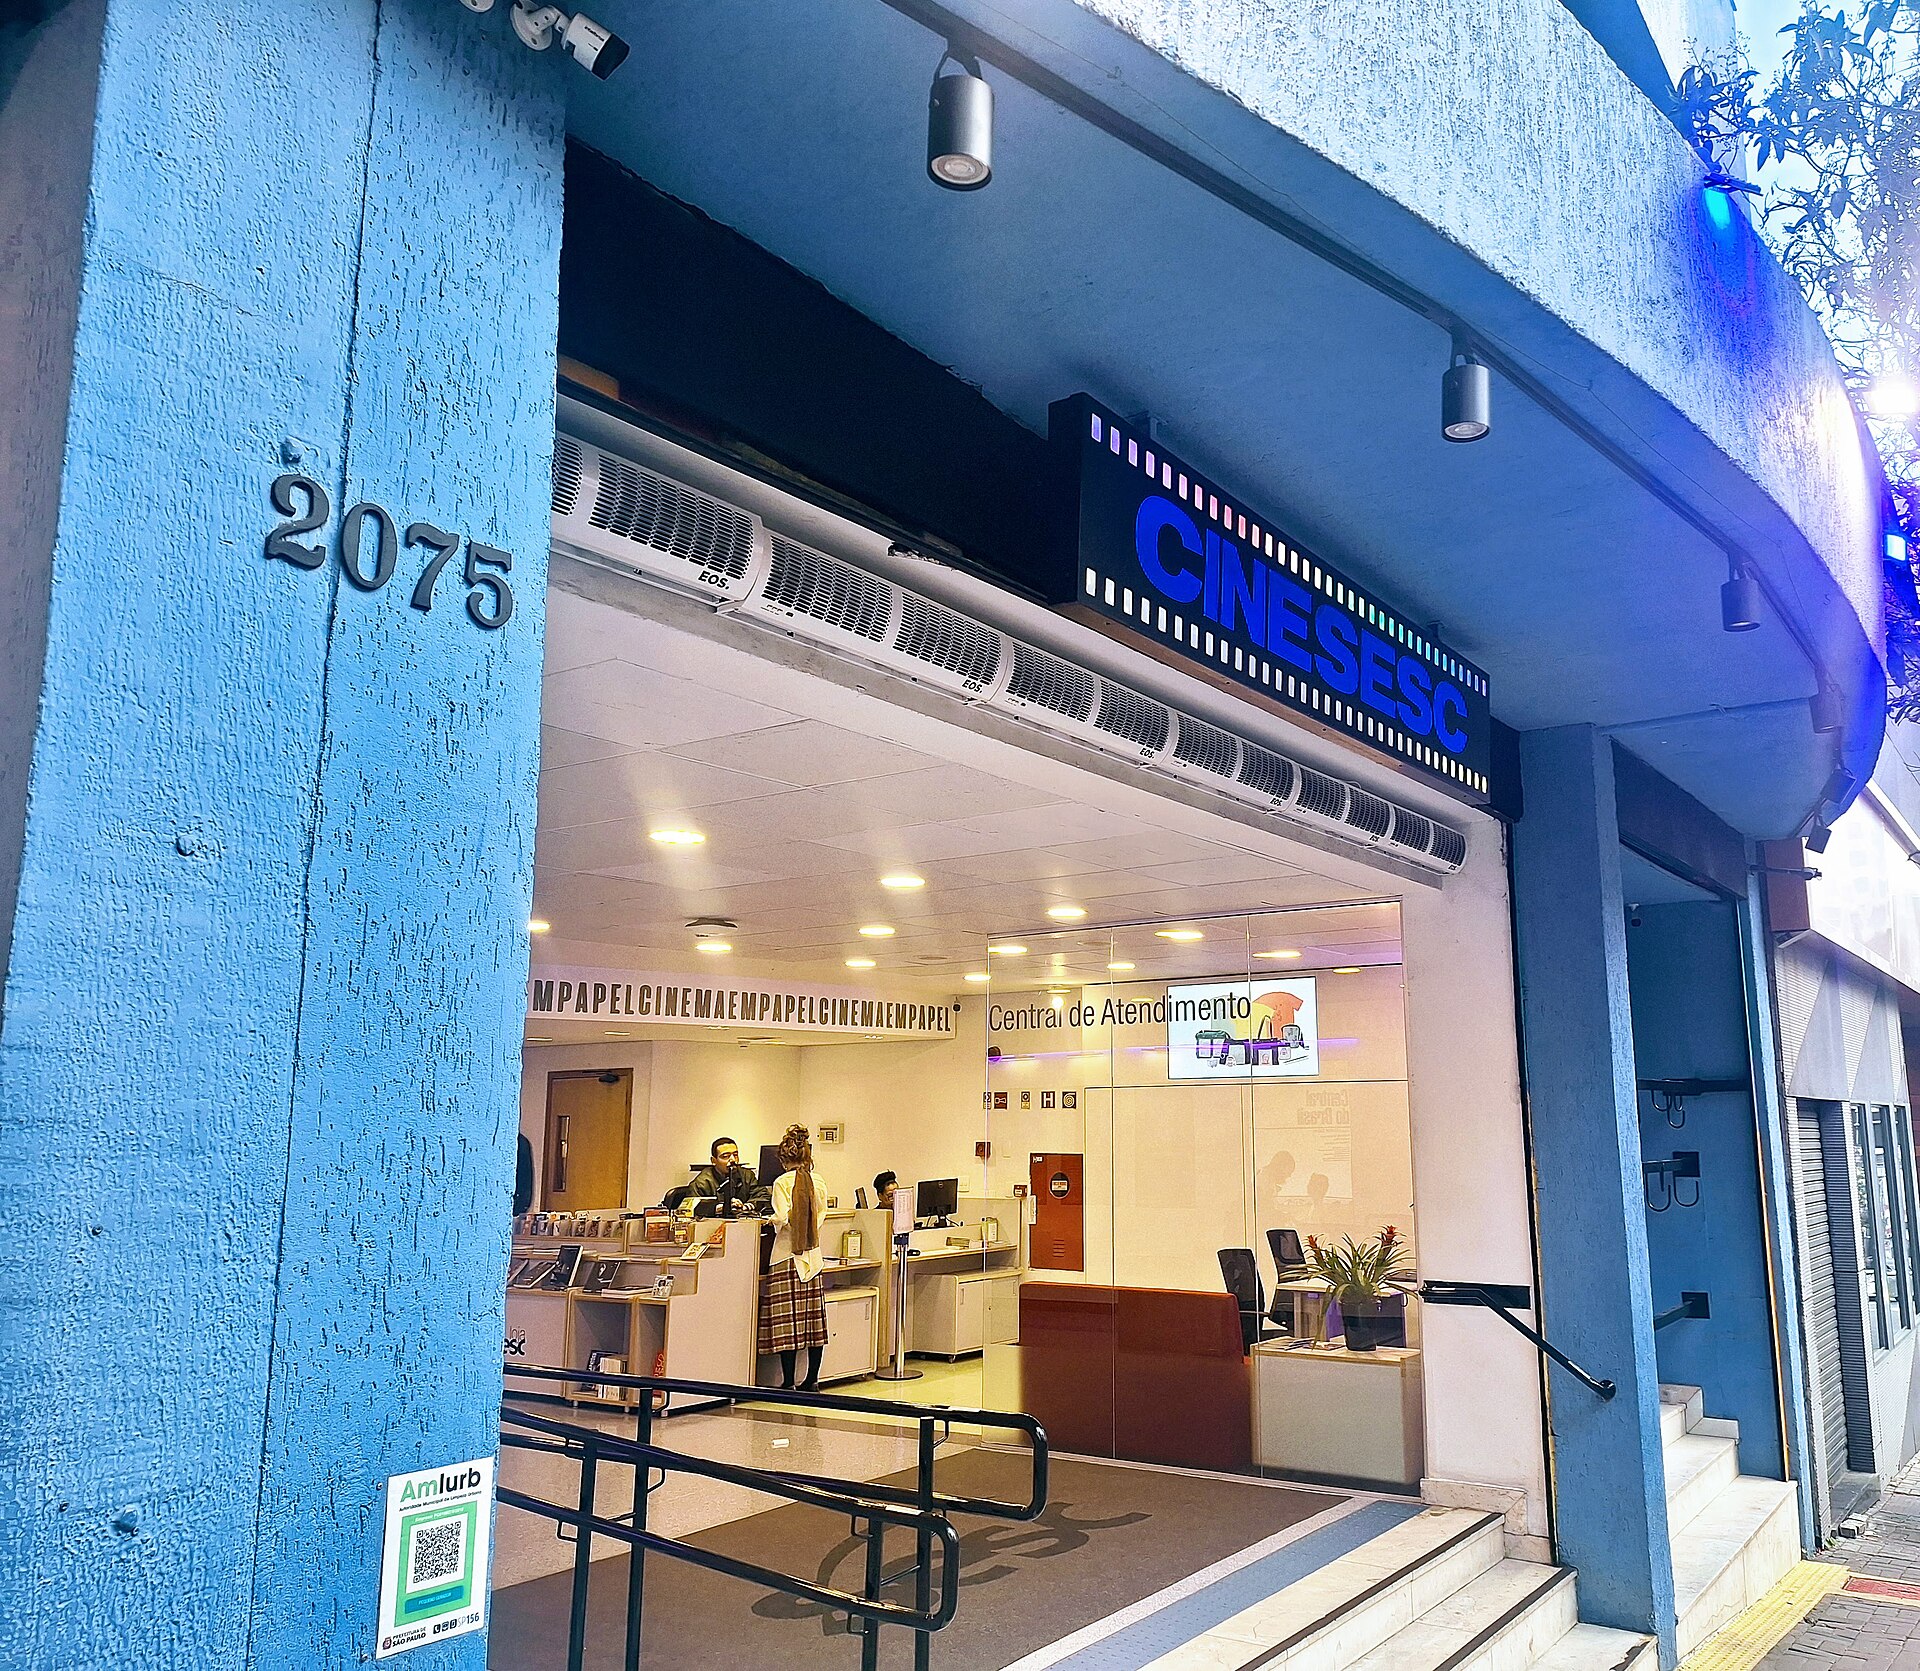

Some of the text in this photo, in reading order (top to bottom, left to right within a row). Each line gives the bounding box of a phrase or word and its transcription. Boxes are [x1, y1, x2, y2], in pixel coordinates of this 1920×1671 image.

[264, 473, 513, 628] 2075
[1135, 495, 1468, 754] CINESESC
[989, 992, 1251, 1031] Central de Atendimento
[399, 1467, 481, 1503] Amlurb
[406, 1632, 427, 1643] PAULO
